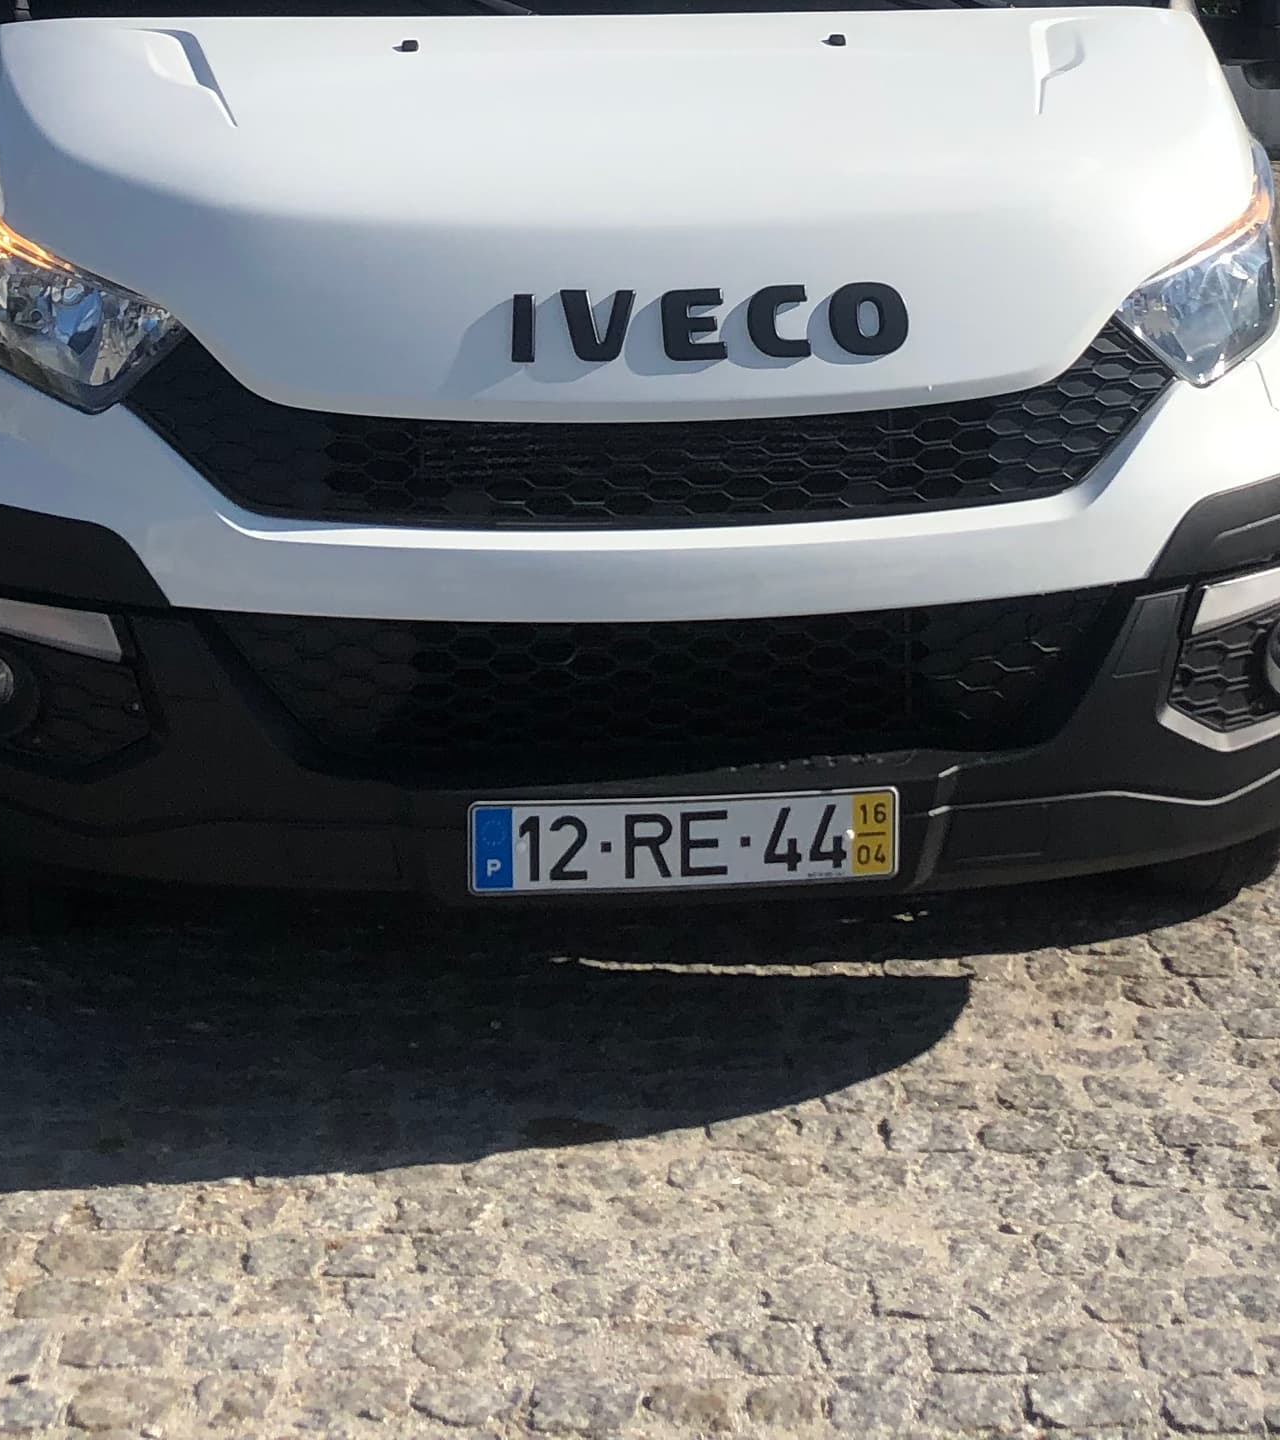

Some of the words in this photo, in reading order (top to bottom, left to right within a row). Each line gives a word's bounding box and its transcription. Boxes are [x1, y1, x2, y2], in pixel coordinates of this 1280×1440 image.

[510, 281, 910, 363] IVECO
[858, 801, 888, 826] 16
[856, 844, 888, 866] 04
[486, 858, 502, 878] P
